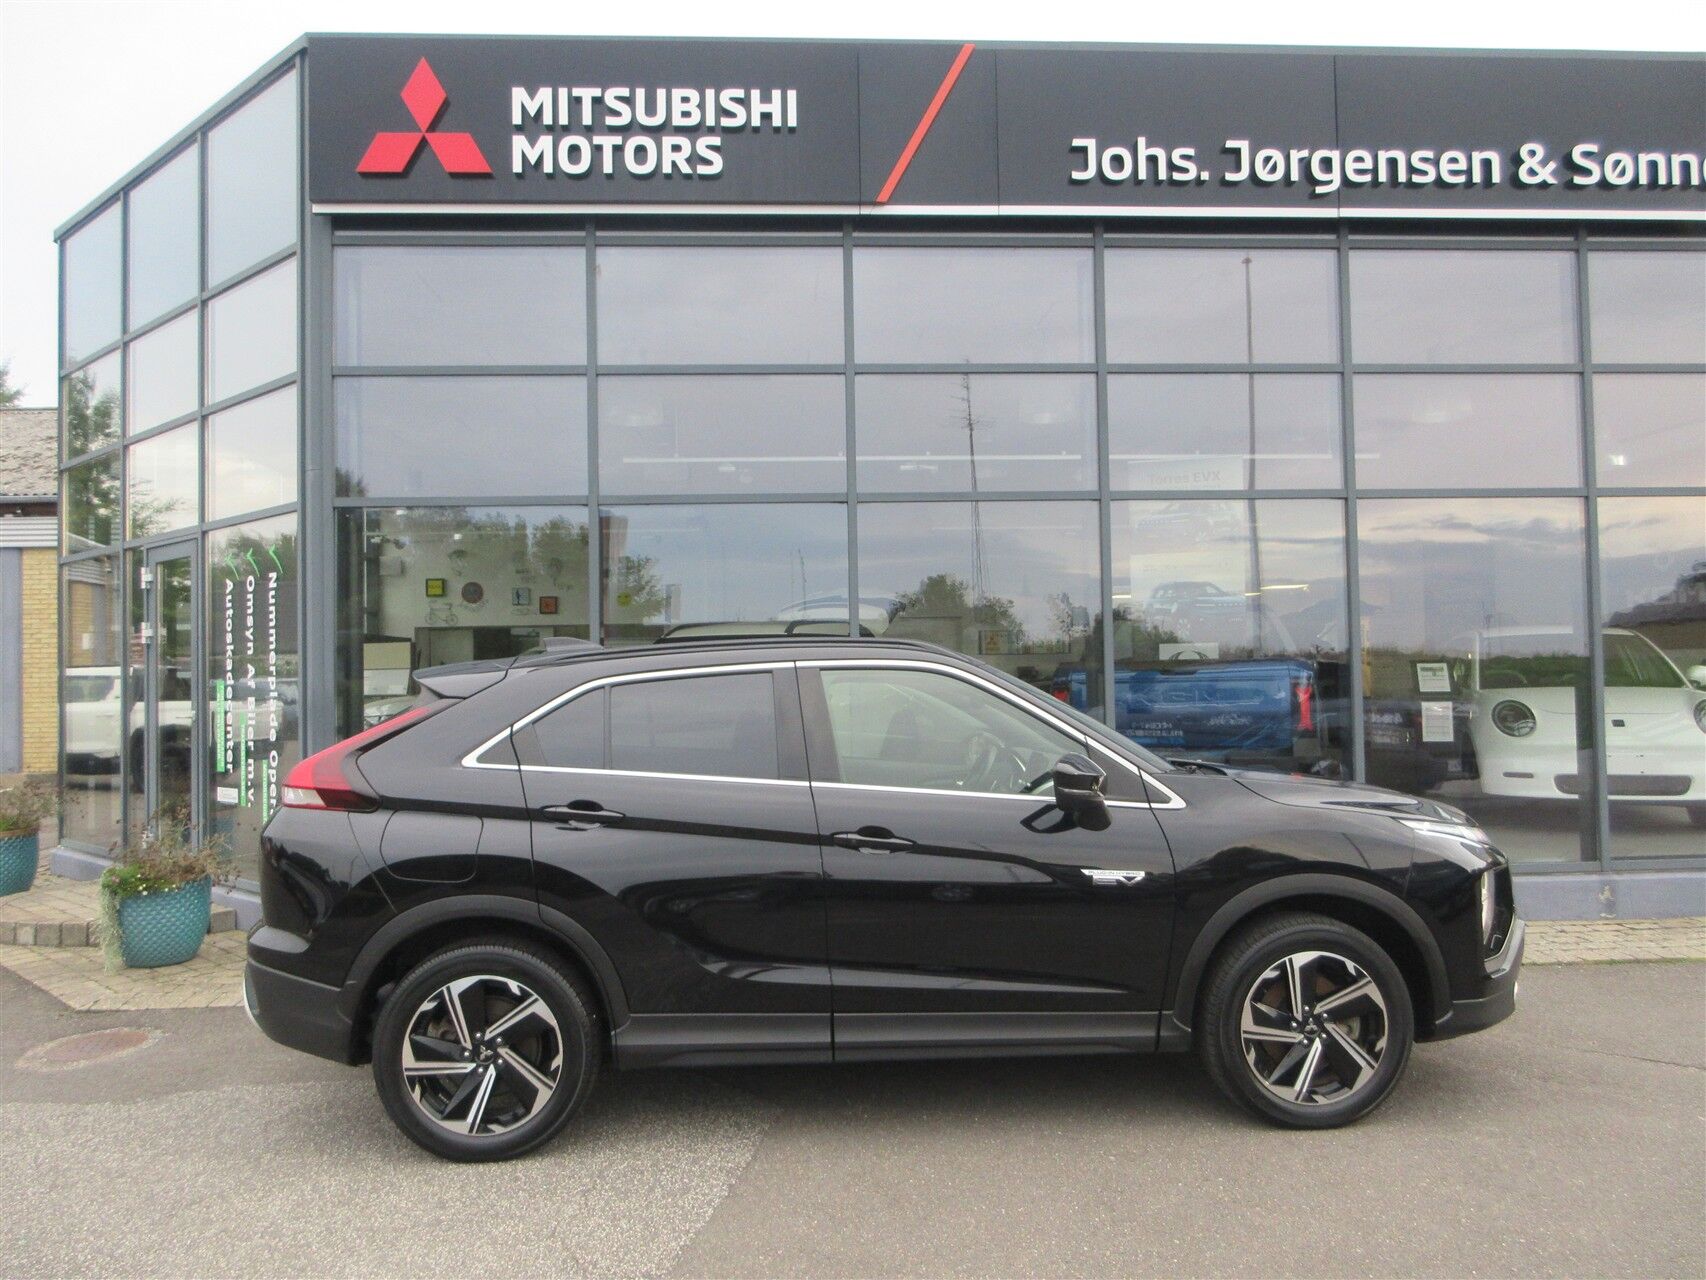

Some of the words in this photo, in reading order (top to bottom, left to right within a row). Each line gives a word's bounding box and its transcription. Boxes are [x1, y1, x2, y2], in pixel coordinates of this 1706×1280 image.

[511, 87, 798, 128] MITSUBISHI
[511, 135, 724, 176] MOTORS
[1070, 136, 1210, 182] Johs.
[1224, 139, 1501, 195] Jørgensen
[1517, 142, 1559, 186] &
[1570, 143, 1706, 186] Sønn
[1193, 470, 1222, 482] EVX
[245, 575, 255, 655] Omsyn
[226, 578, 235, 774] Autoskadecenter
[247, 663, 255, 689] Af
[268, 571, 278, 742] Nummerplade
